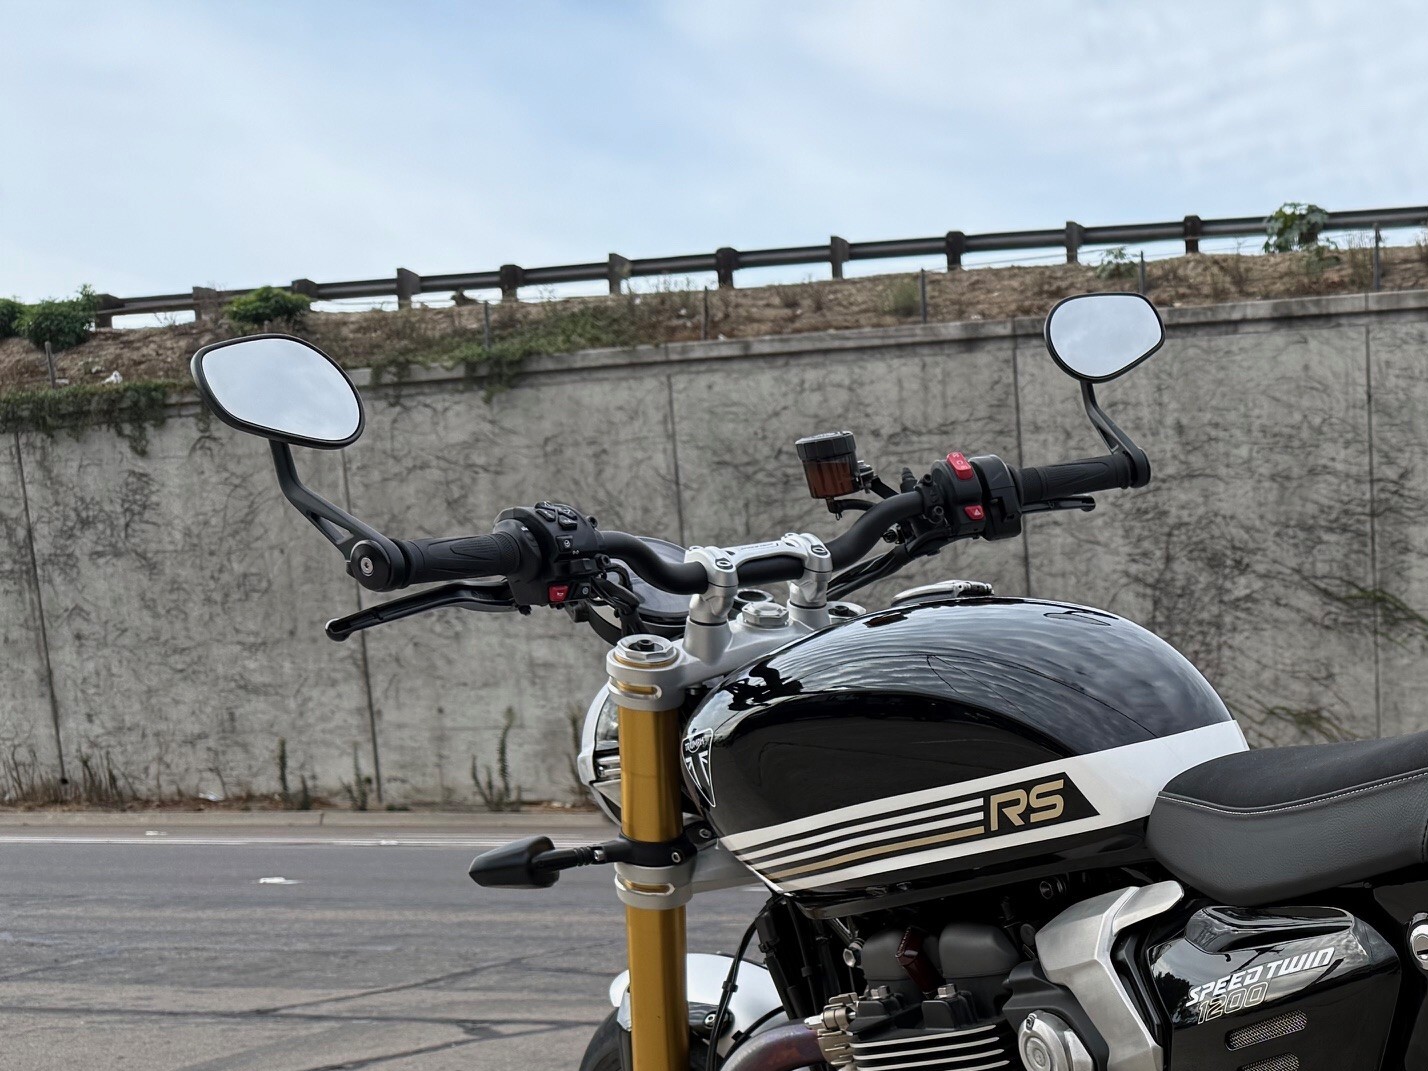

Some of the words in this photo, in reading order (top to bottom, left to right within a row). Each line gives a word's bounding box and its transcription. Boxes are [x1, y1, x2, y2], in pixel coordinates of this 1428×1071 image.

[990, 778, 1065, 832] RS
[1186, 964, 1265, 1007] SPEED
[1266, 947, 1336, 980] TWIN
[1198, 981, 1270, 1025] 1200
